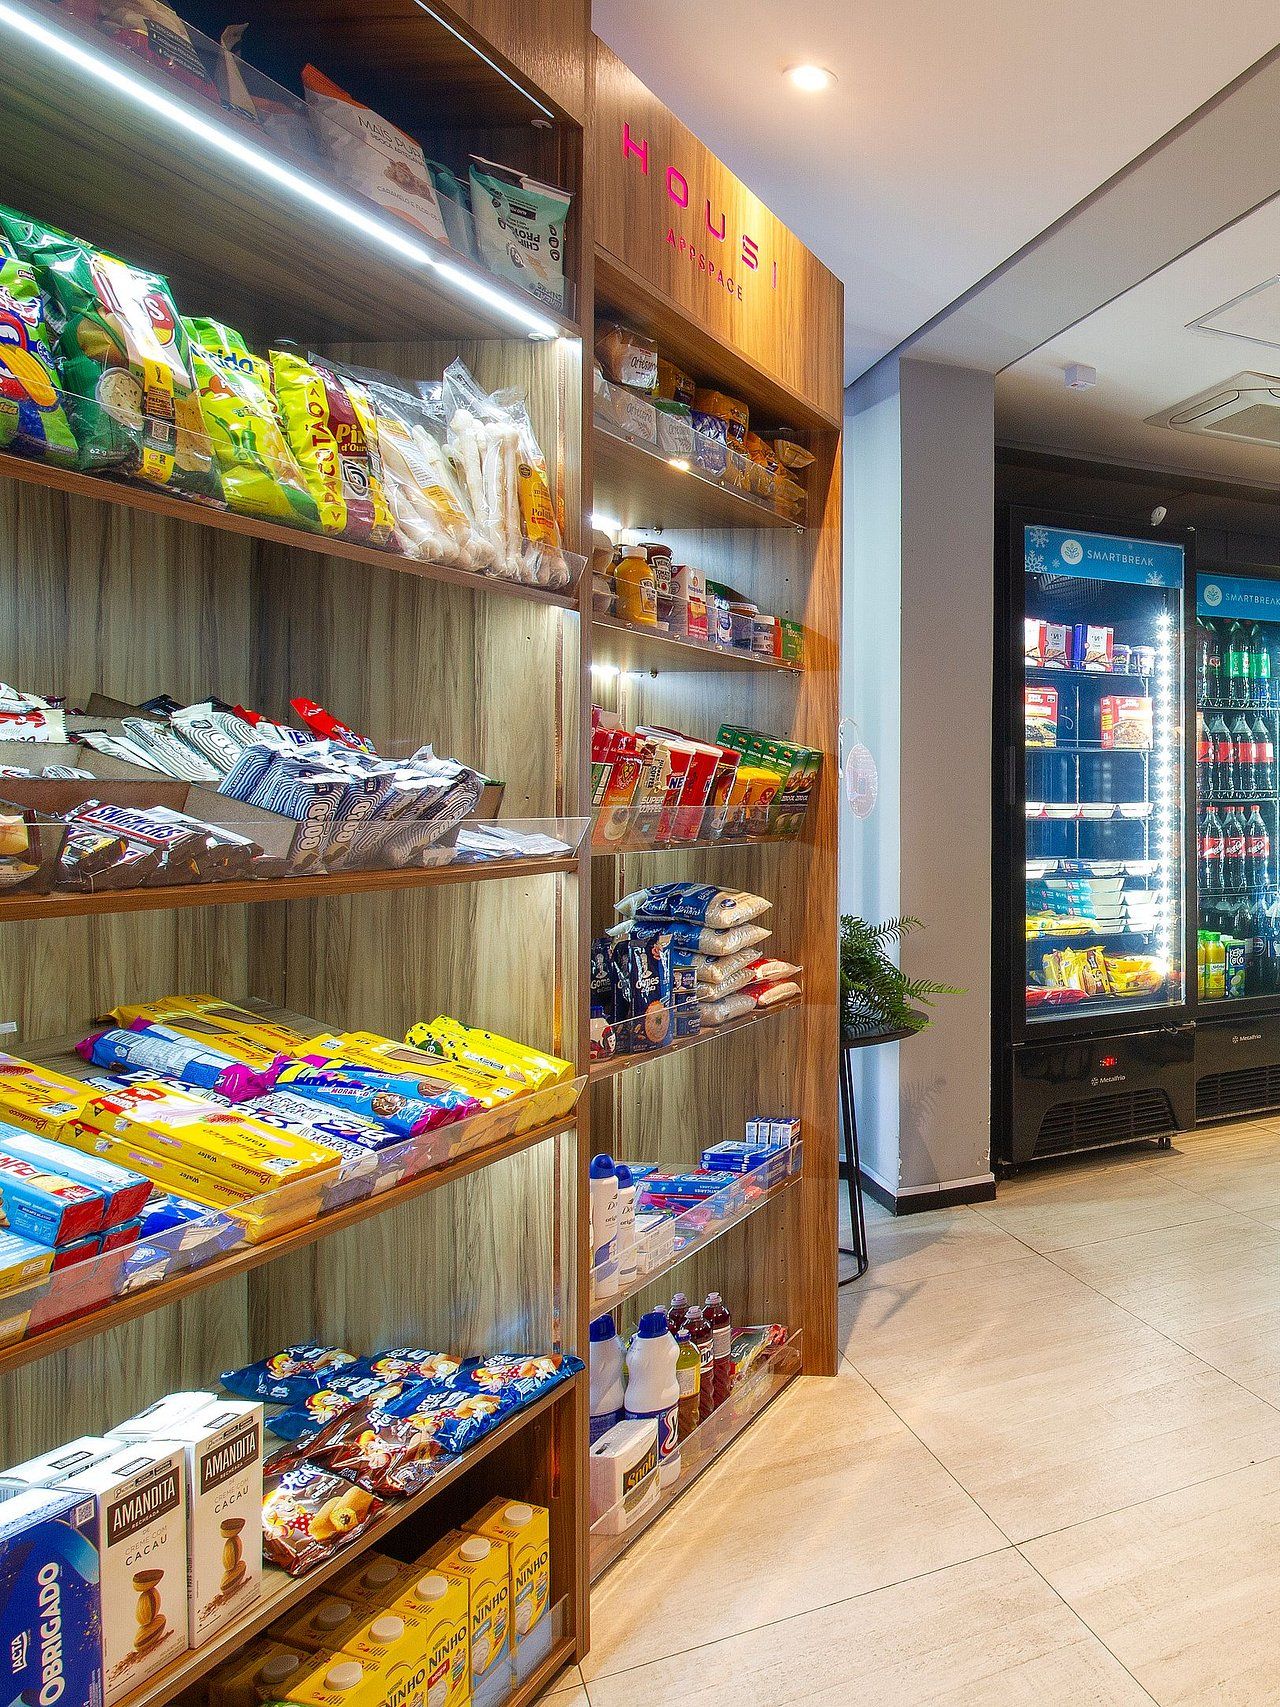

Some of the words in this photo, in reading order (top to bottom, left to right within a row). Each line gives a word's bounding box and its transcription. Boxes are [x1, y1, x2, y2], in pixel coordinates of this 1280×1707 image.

[358, 115, 393, 142] MAIS
[622, 121, 777, 289] HOUSI
[665, 227, 743, 302] APPSPACE
[336, 425, 367, 444] Pin
[1087, 549, 1154, 567] SMARTBREAK
[1225, 592, 1280, 606] SMARTBREAK
[87, 806, 186, 838] SNICKERS
[9, 1108, 48, 1132] Bauducco
[197, 1151, 217, 1164] Wafer
[179, 1172, 200, 1184] Wafer
[231, 1163, 272, 1186] Bauducco
[205, 1431, 256, 1481] AMANDITA
[627, 1452, 656, 1490] Snob
[113, 1476, 176, 1532] AMANDITA
[214, 1485, 249, 1514] CACAU
[131, 1510, 160, 1529] RECHEADA
[125, 1534, 167, 1566] CACAU
[516, 1551, 549, 1592] NINHO
[472, 1586, 508, 1630] NINHO
[37, 1562, 66, 1706] OBRIGADO
[429, 1625, 467, 1673] NINHO
[11, 1632, 27, 1675] LACTA
